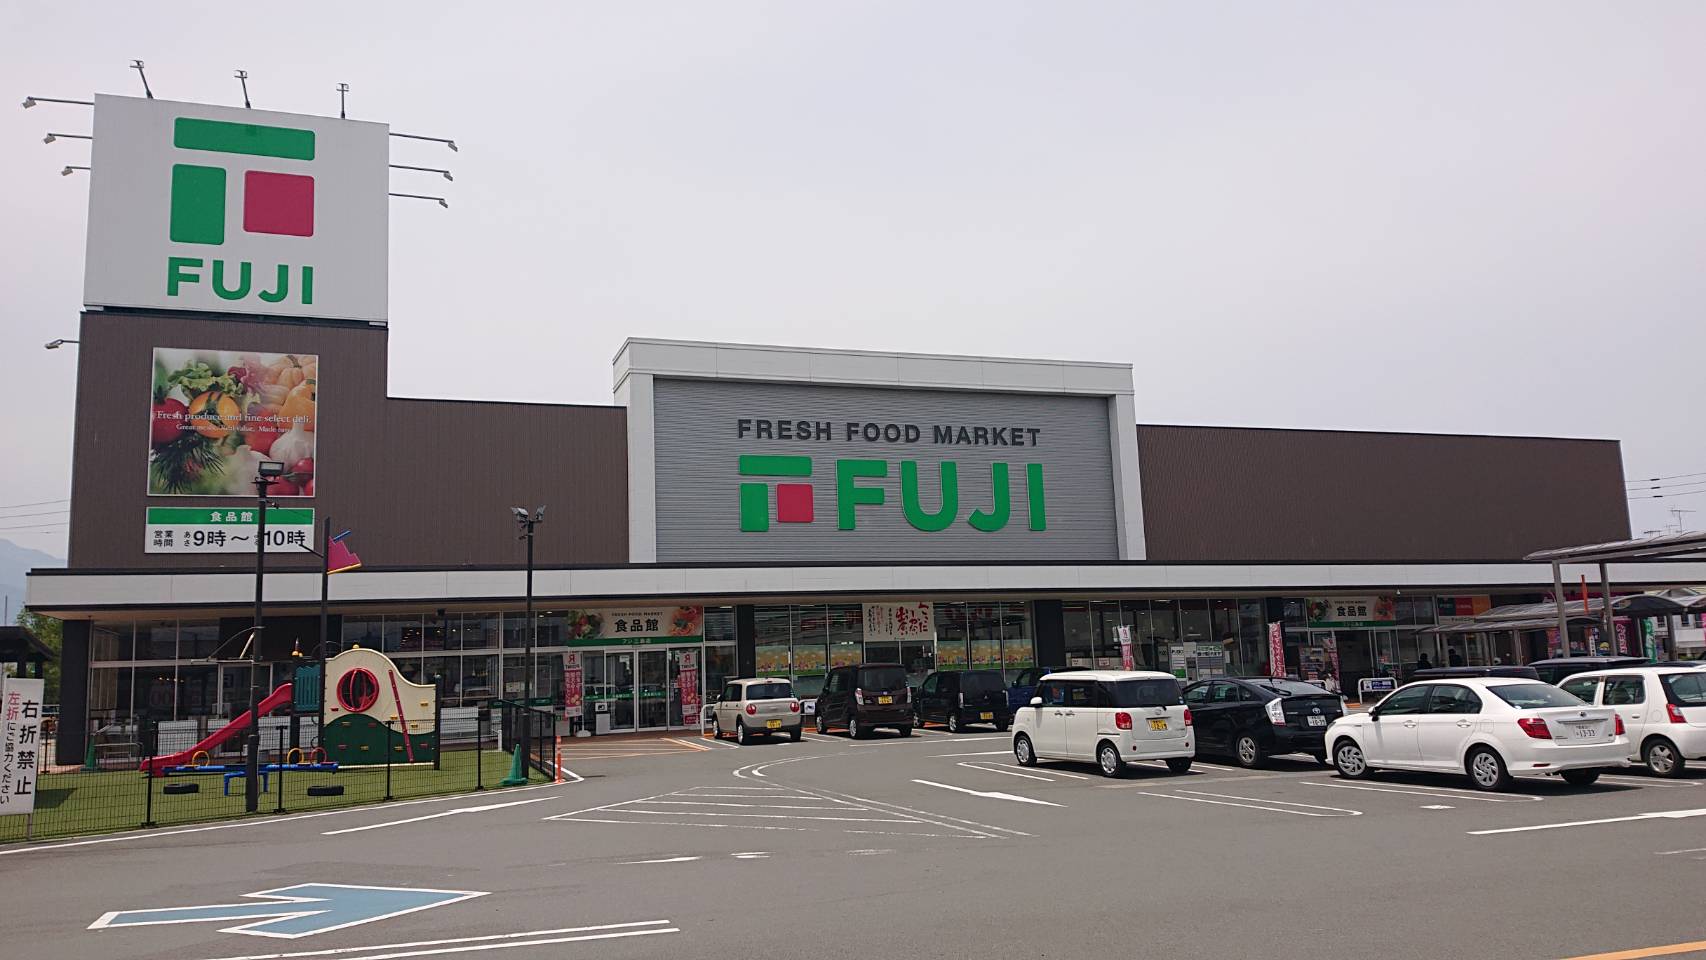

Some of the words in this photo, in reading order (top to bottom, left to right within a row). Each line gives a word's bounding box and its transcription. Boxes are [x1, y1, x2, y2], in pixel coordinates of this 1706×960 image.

[167, 256, 314, 305] FUJI
[157, 410, 183, 420] Fresh
[184, 410, 222, 422] produce
[264, 414, 291, 423] select
[292, 414, 312, 424] deli.
[737, 419, 832, 442] FRESH
[846, 422, 921, 444] FOOD
[933, 425, 1041, 447] MARKET
[835, 458, 1047, 533] FUJI
[209, 511, 253, 522] 食品館
[153, 530, 174, 538] 営業
[183, 530, 192, 547] あさ
[153, 538, 174, 547] 時間
[614, 618, 659, 633] 食品館
[14, 699, 39, 795] 右折禁止
